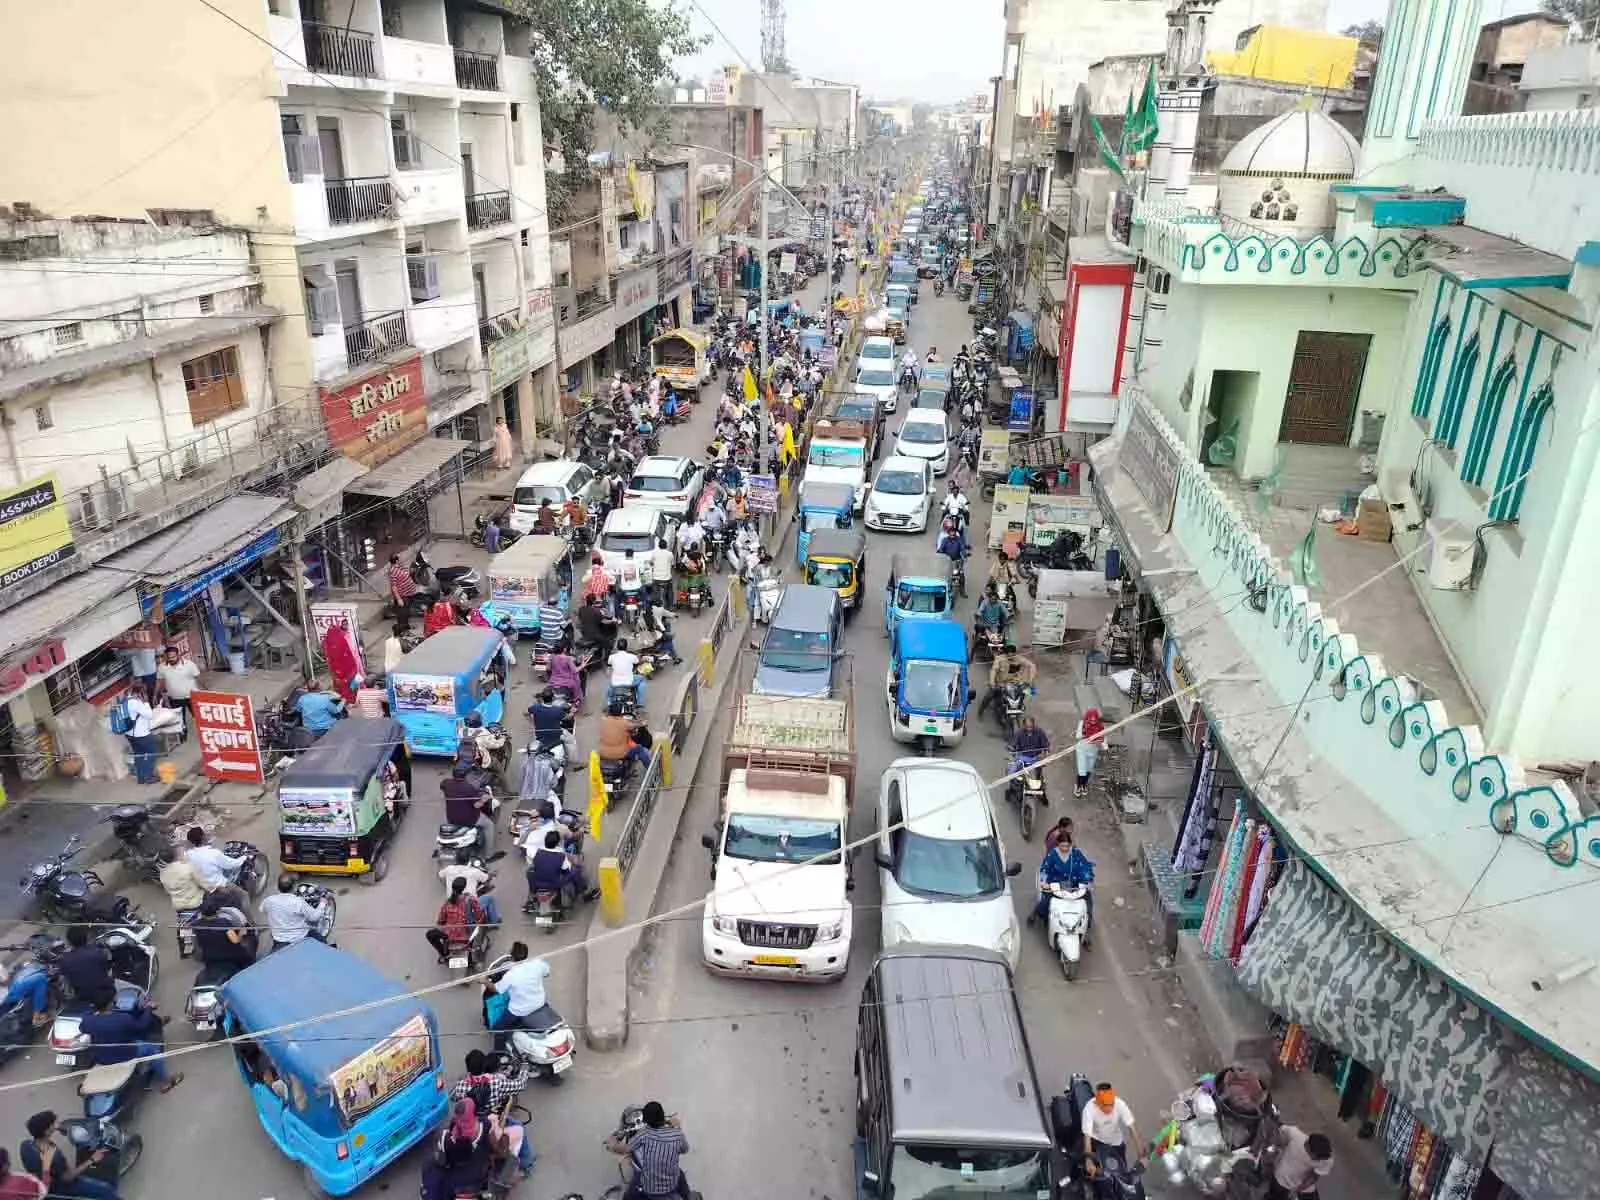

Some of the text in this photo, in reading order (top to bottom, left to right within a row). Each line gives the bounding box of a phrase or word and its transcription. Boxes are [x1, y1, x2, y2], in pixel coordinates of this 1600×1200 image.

[4, 566, 31, 584] BOOK
[32, 551, 60, 570] DEPOT
[197, 698, 246, 727] दवाई
[200, 727, 254, 753] दुकान
